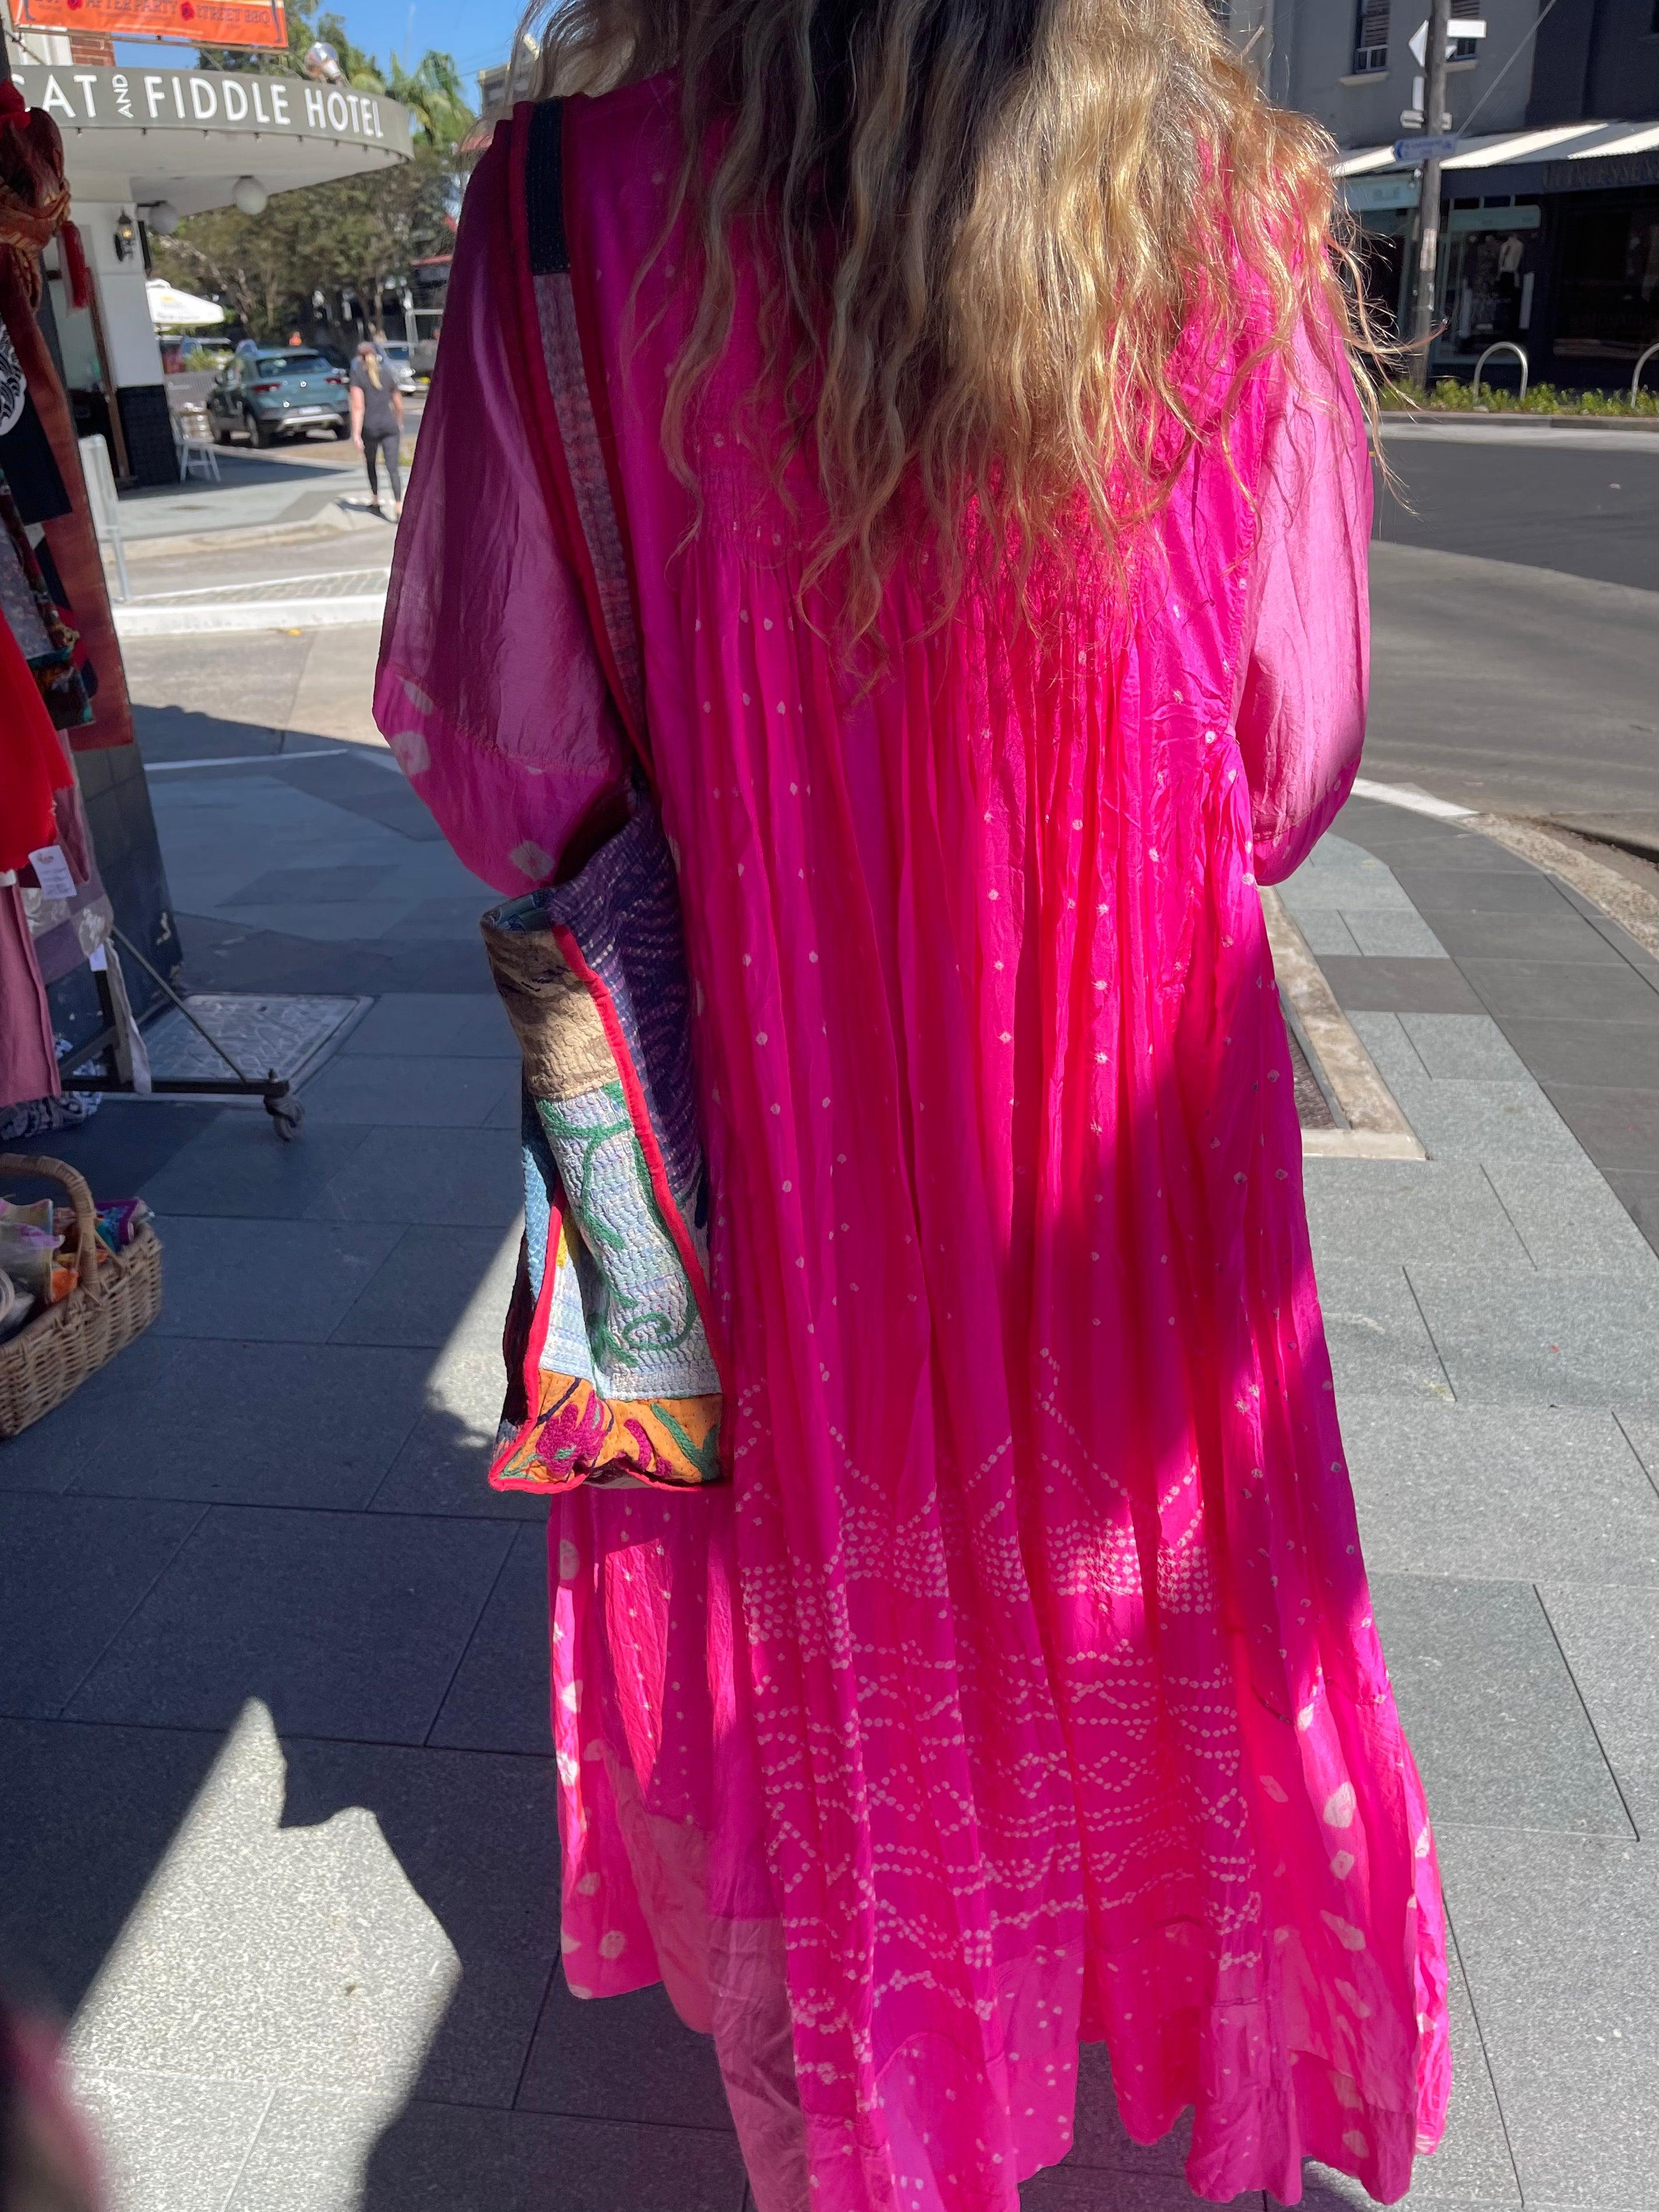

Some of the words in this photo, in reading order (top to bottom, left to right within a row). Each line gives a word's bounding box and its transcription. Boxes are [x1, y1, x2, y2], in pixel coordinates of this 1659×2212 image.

[12, 74, 97, 118] AT
[112, 74, 133, 118] AND
[144, 76, 290, 124] FIDDLE
[305, 89, 384, 138] HOTEL
